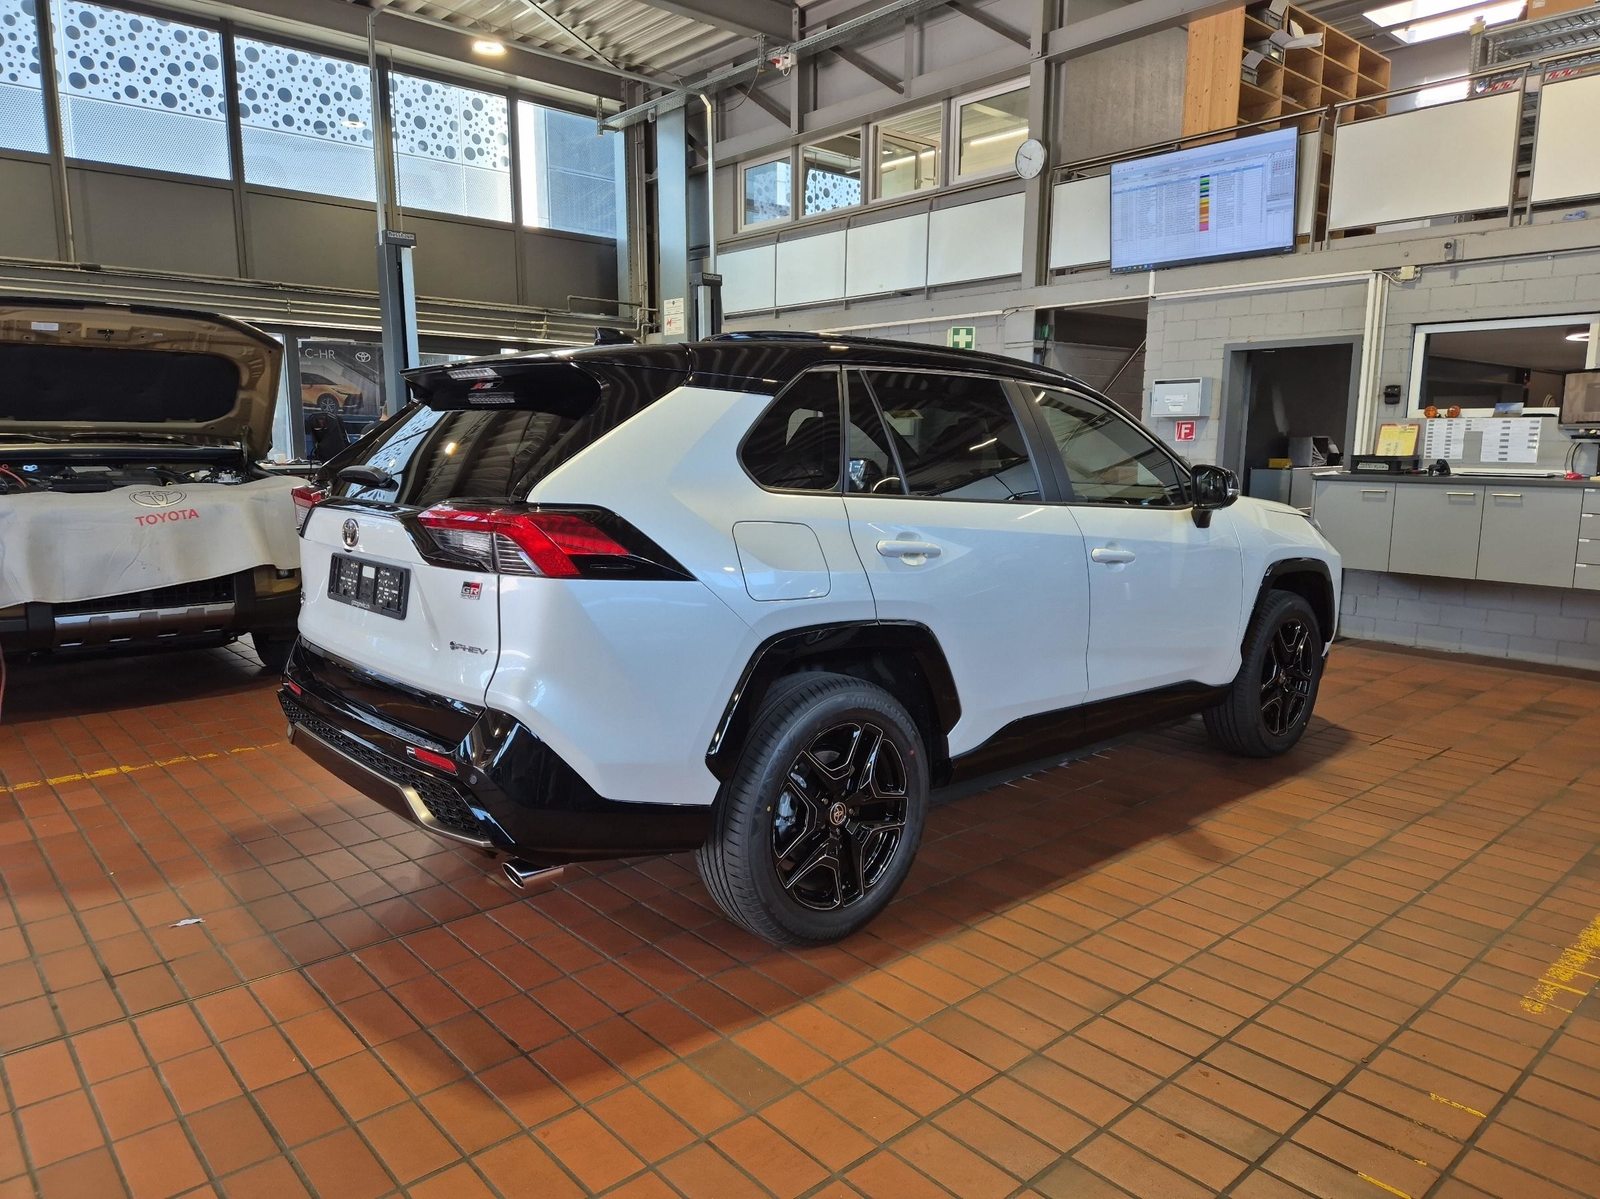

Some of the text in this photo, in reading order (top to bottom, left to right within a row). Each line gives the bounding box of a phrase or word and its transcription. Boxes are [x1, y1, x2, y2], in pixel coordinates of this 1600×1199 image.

[304, 348, 336, 360] C-HR
[1181, 424, 1192, 439] F
[135, 509, 199, 526] TOYOTA
[462, 586, 480, 595] GR
[456, 643, 488, 655] PHEV
